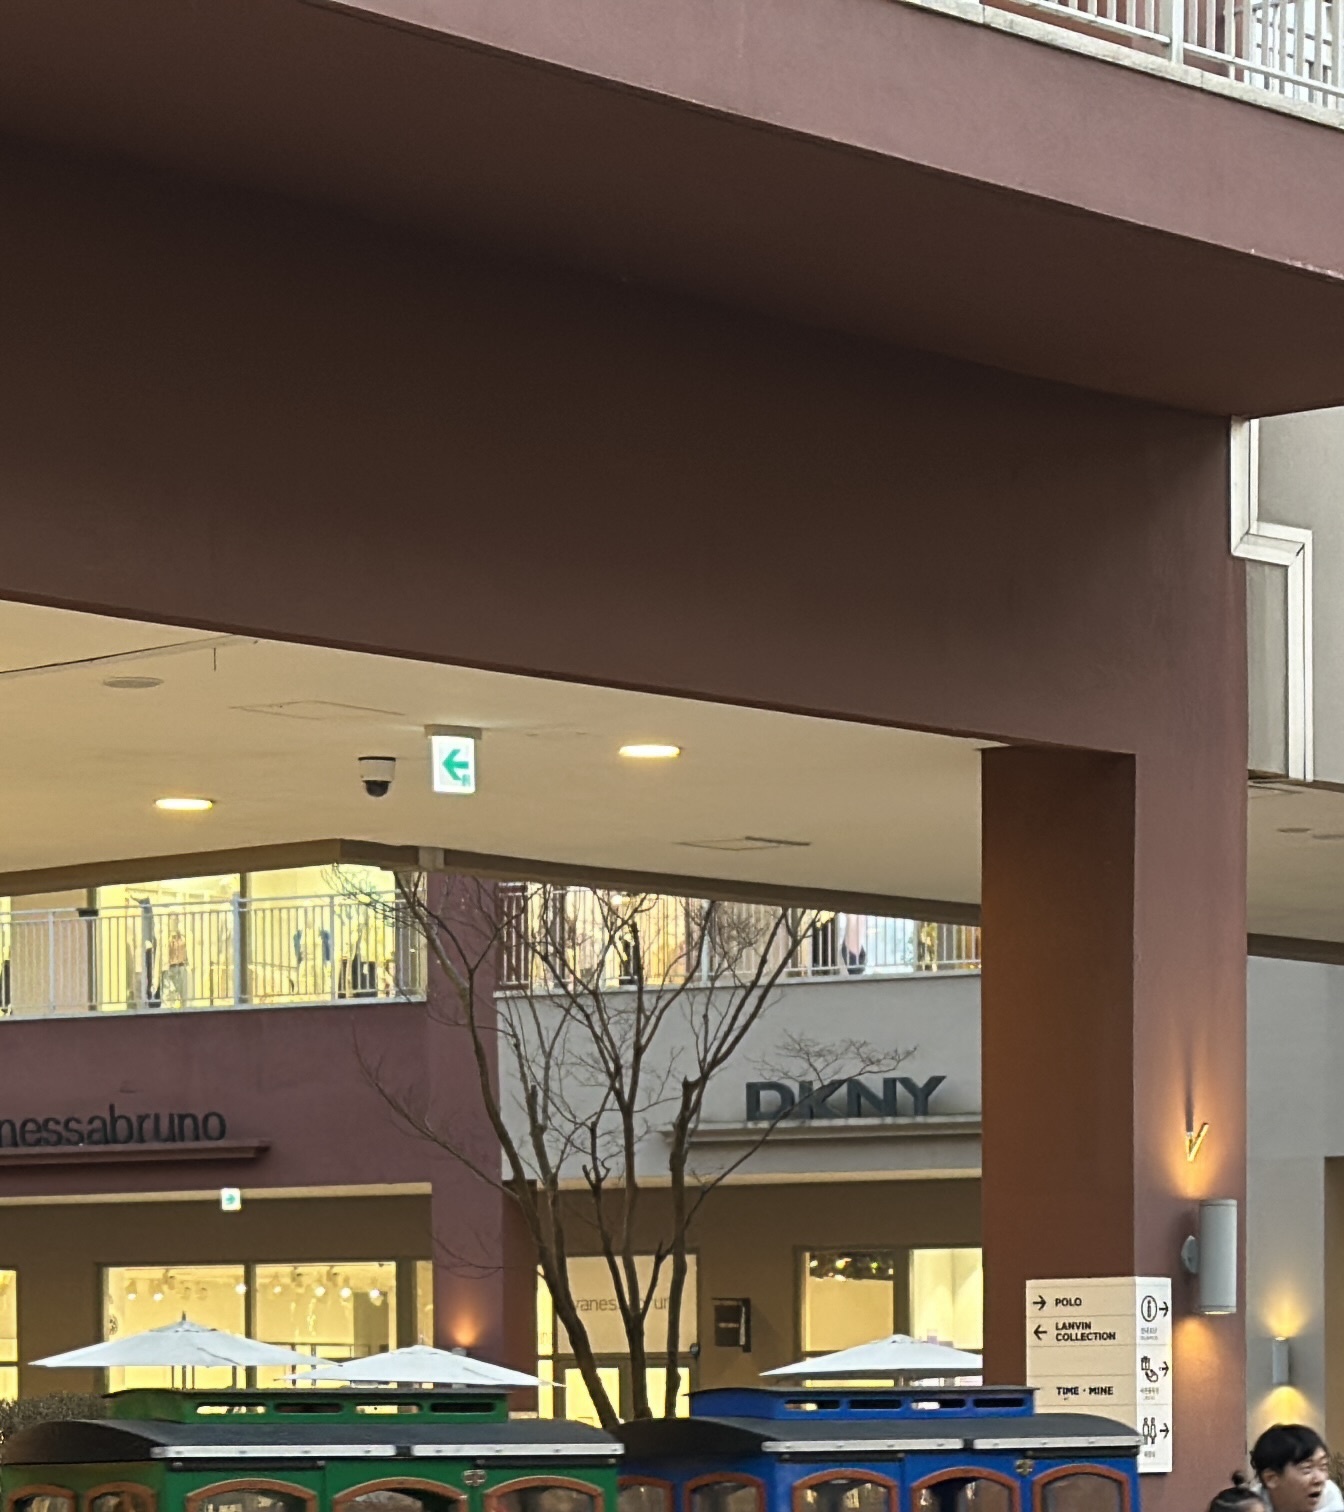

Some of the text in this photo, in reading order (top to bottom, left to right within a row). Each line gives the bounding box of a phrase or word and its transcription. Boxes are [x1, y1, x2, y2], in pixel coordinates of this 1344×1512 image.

[746, 1076, 946, 1121] DKNY
[1055, 1297, 1082, 1307] POLO
[1055, 1321, 1092, 1331] LANVIN
[1055, 1332, 1116, 1341] COLLECTION
[1056, 1386, 1080, 1396] TIME
[1088, 1386, 1114, 1395] MINE
